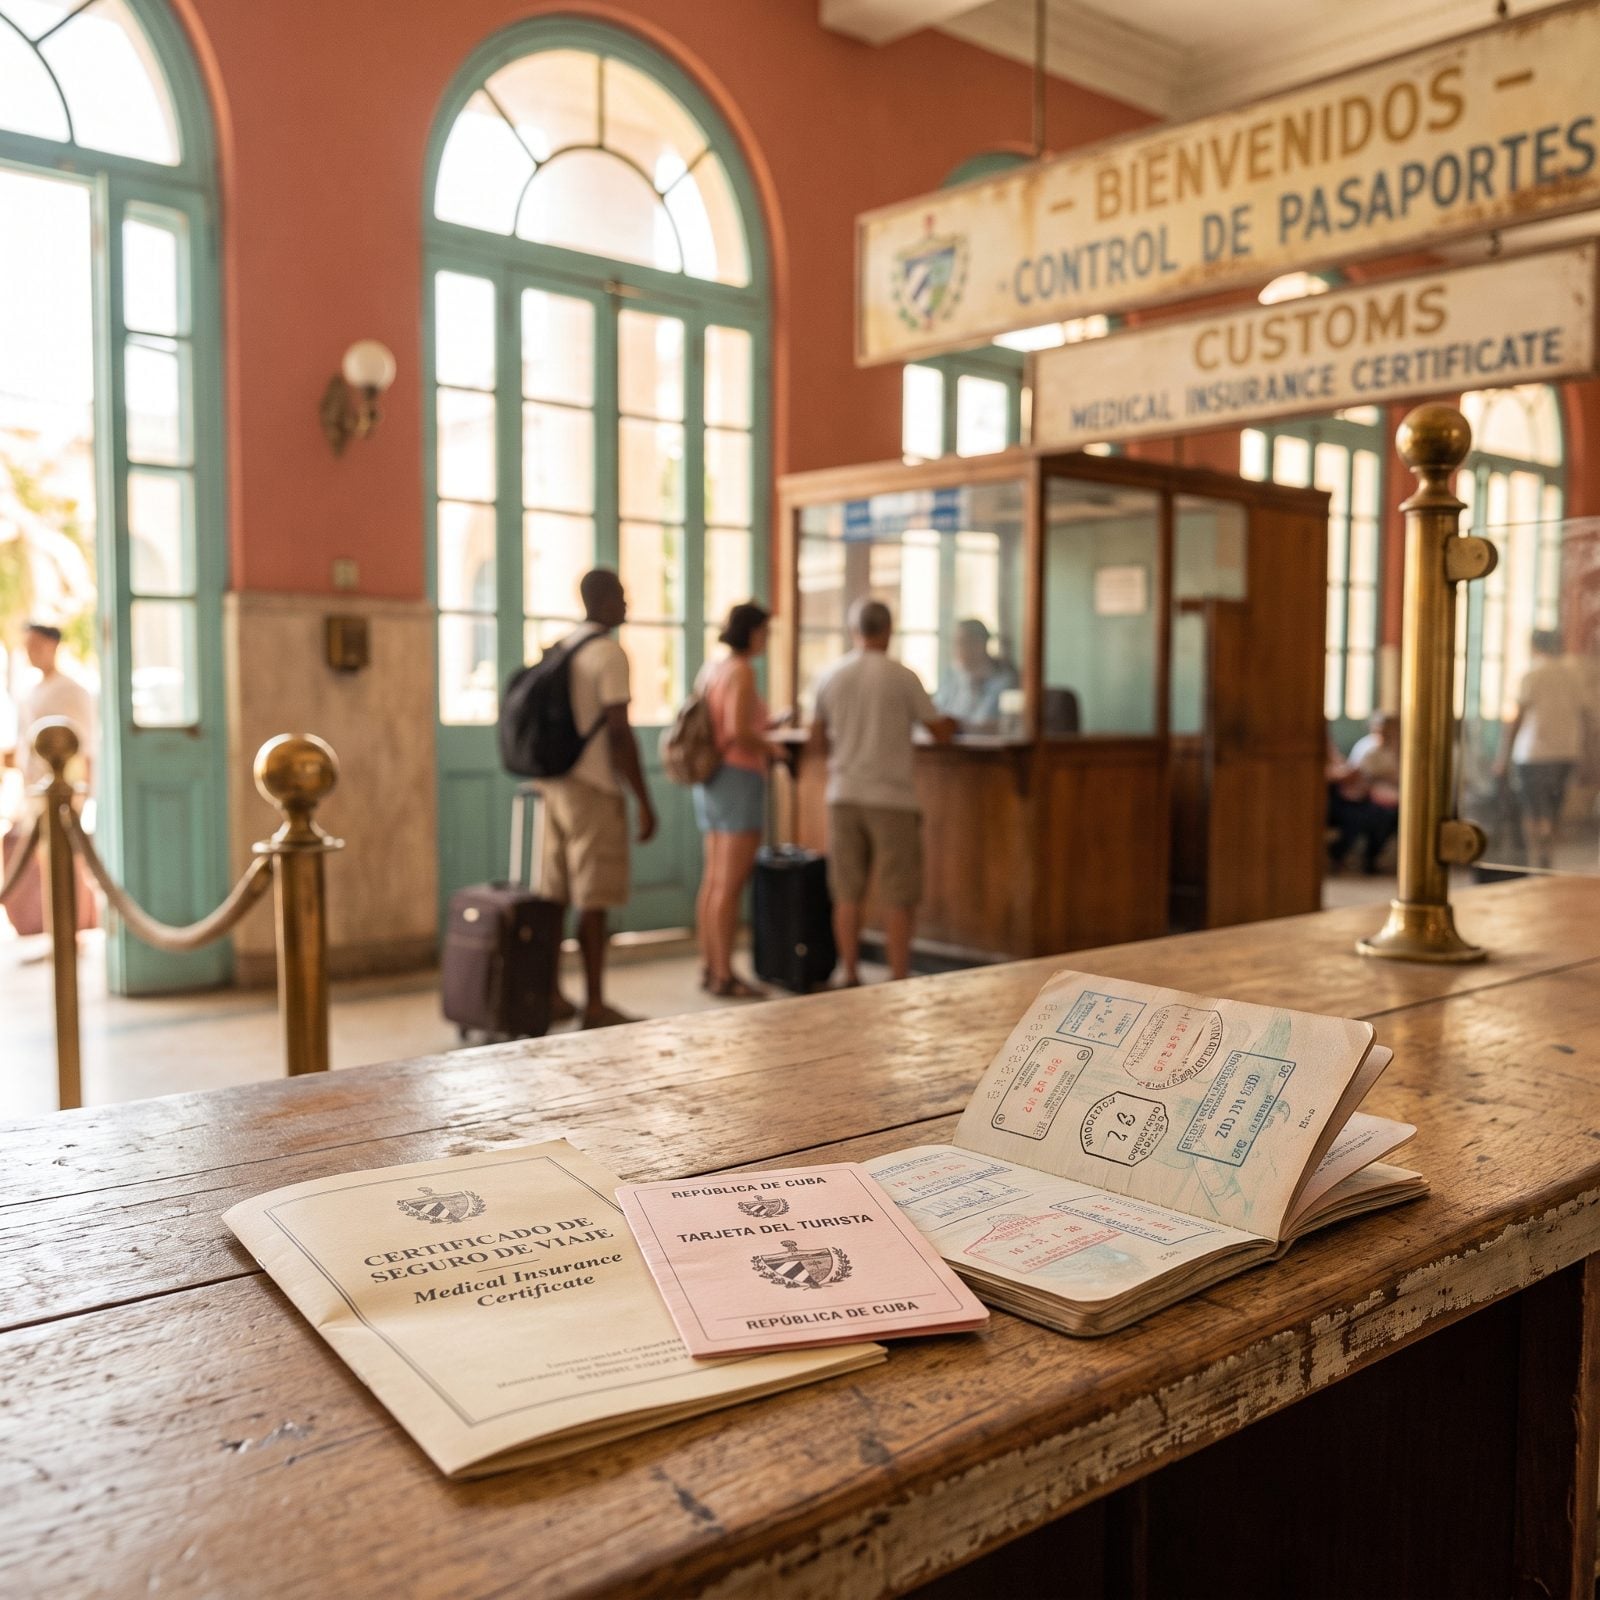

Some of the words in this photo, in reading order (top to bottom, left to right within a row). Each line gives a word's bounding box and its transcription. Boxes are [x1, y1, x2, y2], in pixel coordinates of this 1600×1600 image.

[1094, 66, 1467, 224] BIENVENIDOS
[1014, 236, 1178, 305] CONTROL
[1203, 205, 1252, 263] DE
[1278, 116, 1596, 245] PASAPORTES
[1193, 284, 1449, 372] CUSTOMS
[1070, 382, 1171, 432] MEDICAL
[1186, 365, 1335, 416] INSURANCE
[1352, 328, 1563, 392] CERTIFICATE
[672, 1182, 755, 1199] REPÚBLICA
[762, 1180, 782, 1190] DE
[786, 1176, 826, 1188] CUBA
[364, 1223, 551, 1267] CERTIFICADO
[556, 1216, 594, 1232] DE
[677, 1227, 755, 1243] TARJETA
[759, 1222, 794, 1234] DEL
[797, 1214, 874, 1230] TURISTA
[370, 1251, 488, 1283] SEGURO
[493, 1243, 533, 1260] DE
[535, 1228, 614, 1250] VIAJE
[414, 1275, 505, 1305] Medical
[513, 1253, 623, 1283] Insurance
[477, 1275, 595, 1307] Certificate
[746, 1310, 842, 1330] REPÚBLICA
[846, 1307, 869, 1318] DE
[873, 1300, 919, 1315] CUBA
